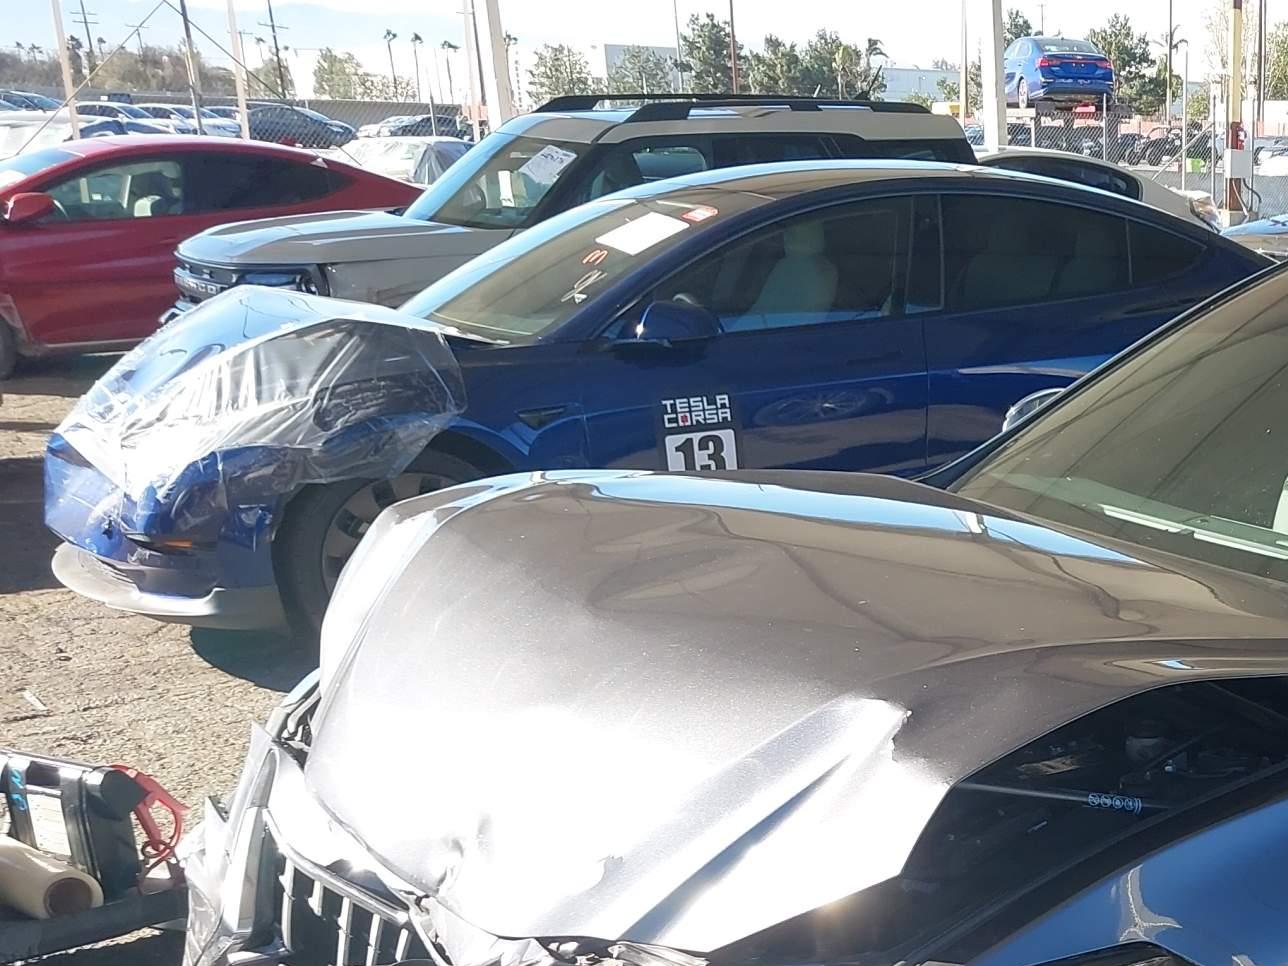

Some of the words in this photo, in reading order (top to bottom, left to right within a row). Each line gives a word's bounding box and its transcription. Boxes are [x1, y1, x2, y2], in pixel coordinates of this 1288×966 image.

[661, 394, 730, 414] TESLA
[663, 408, 732, 429] CORSA
[674, 434, 727, 471] 13
